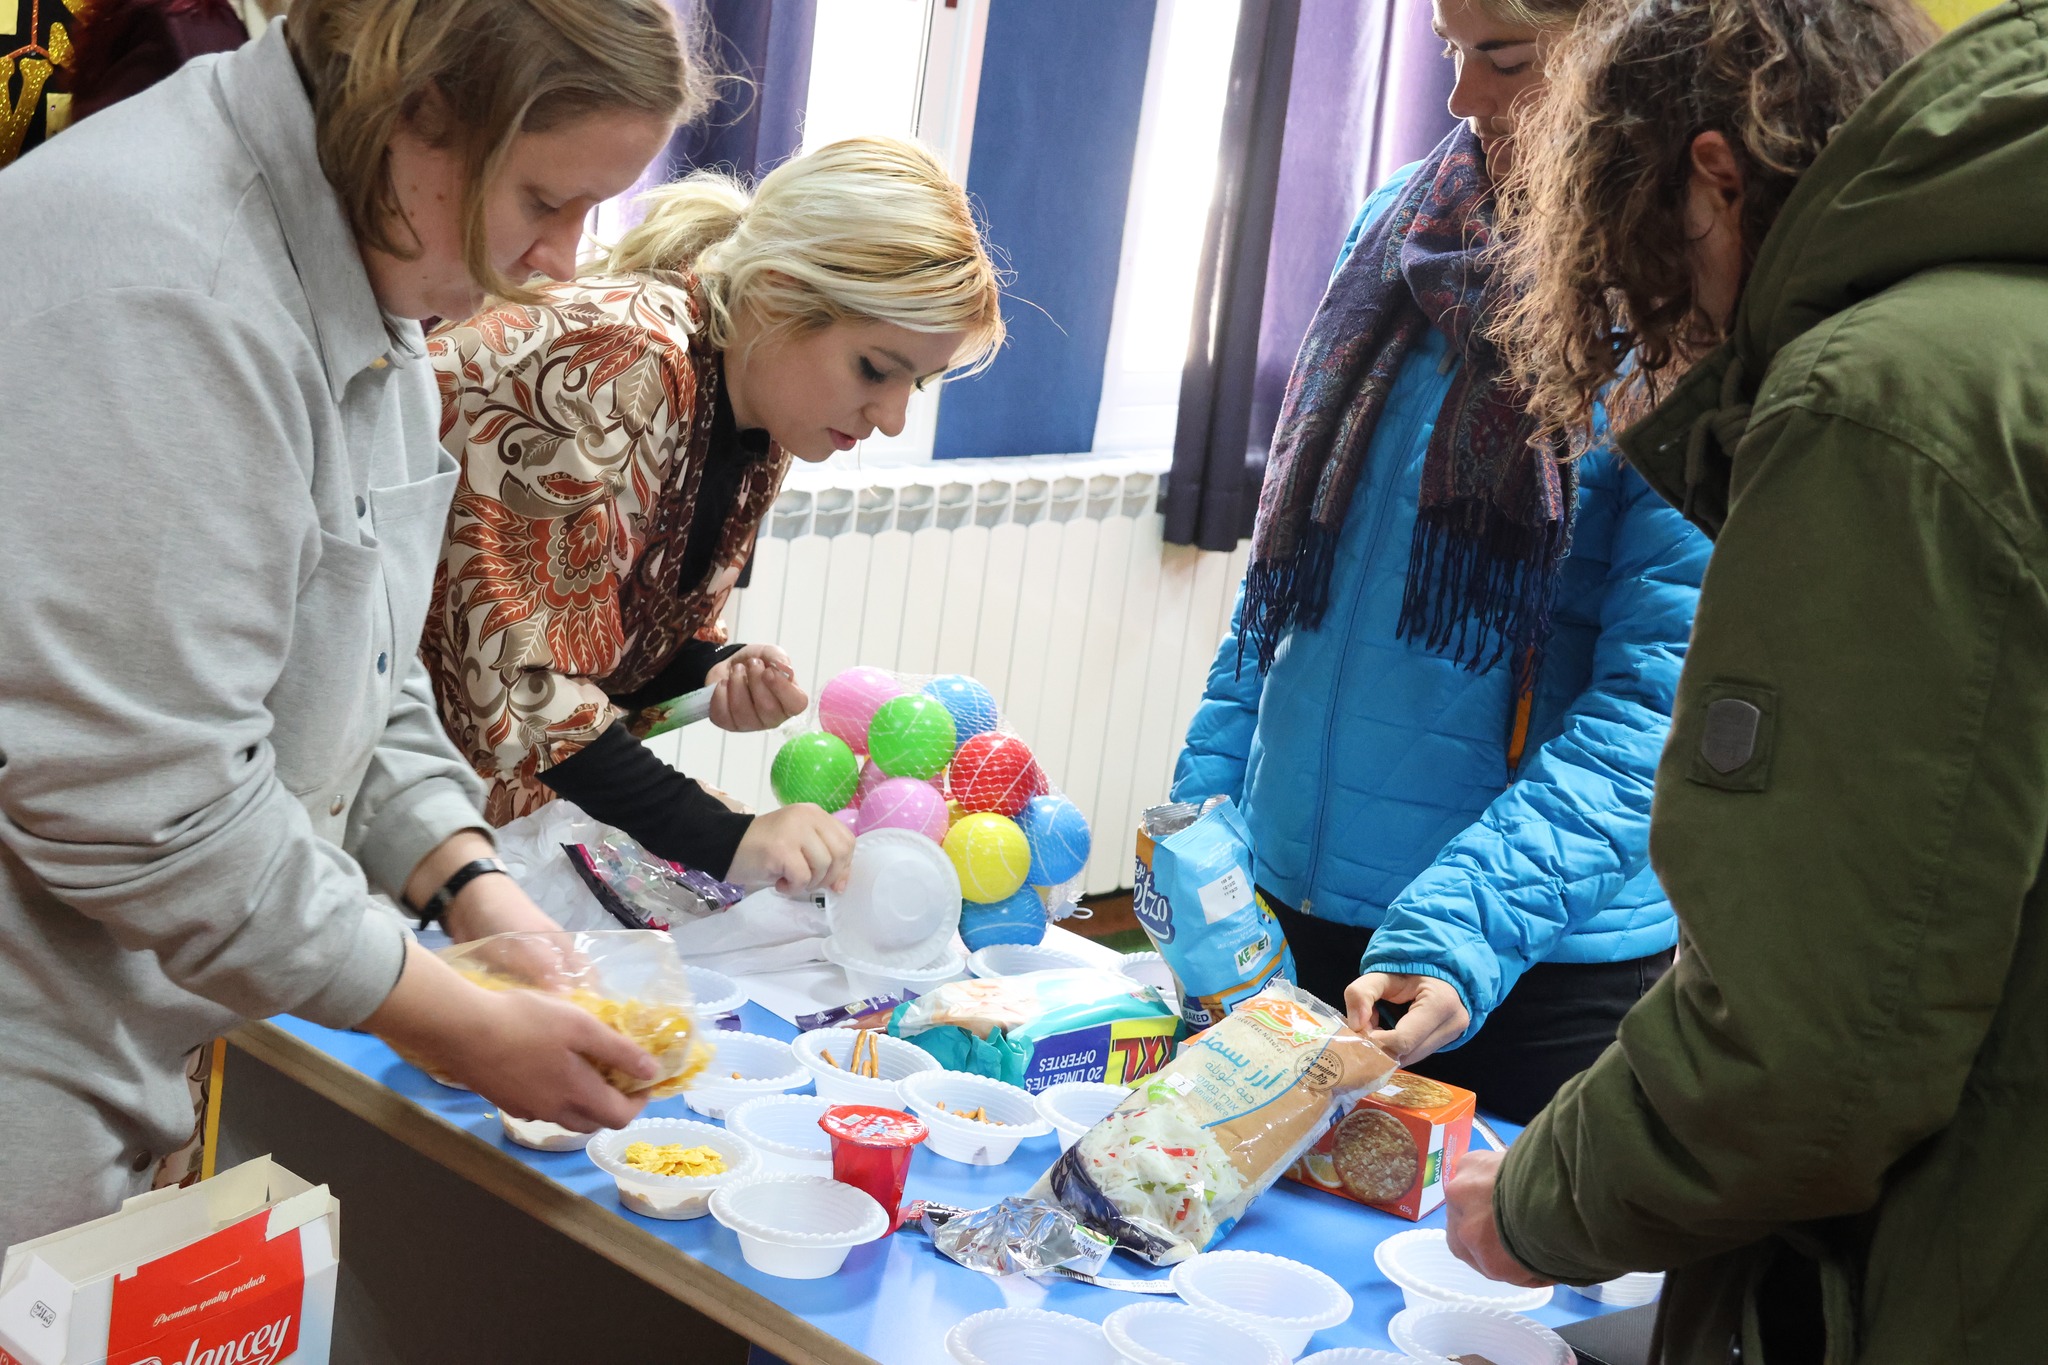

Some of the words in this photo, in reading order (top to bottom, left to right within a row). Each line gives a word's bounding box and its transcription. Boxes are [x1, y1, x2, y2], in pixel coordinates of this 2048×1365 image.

[1184, 1010, 1210, 1023] BAKED
[1262, 1031, 1286, 1054] Natural
[1039, 1049, 1097, 1073] OFFERTES
[1087, 1065, 1104, 1080] 20
[1302, 1055, 1338, 1080] Premium
[1025, 1068, 1086, 1092] LINGETTES
[1243, 1064, 1290, 1091] أرز
[1300, 1065, 1329, 1086] Quality
[1212, 1100, 1229, 1117] Rice
[153, 1302, 198, 1328] Premium
[200, 1290, 230, 1312] quality
[230, 1274, 267, 1299] products
